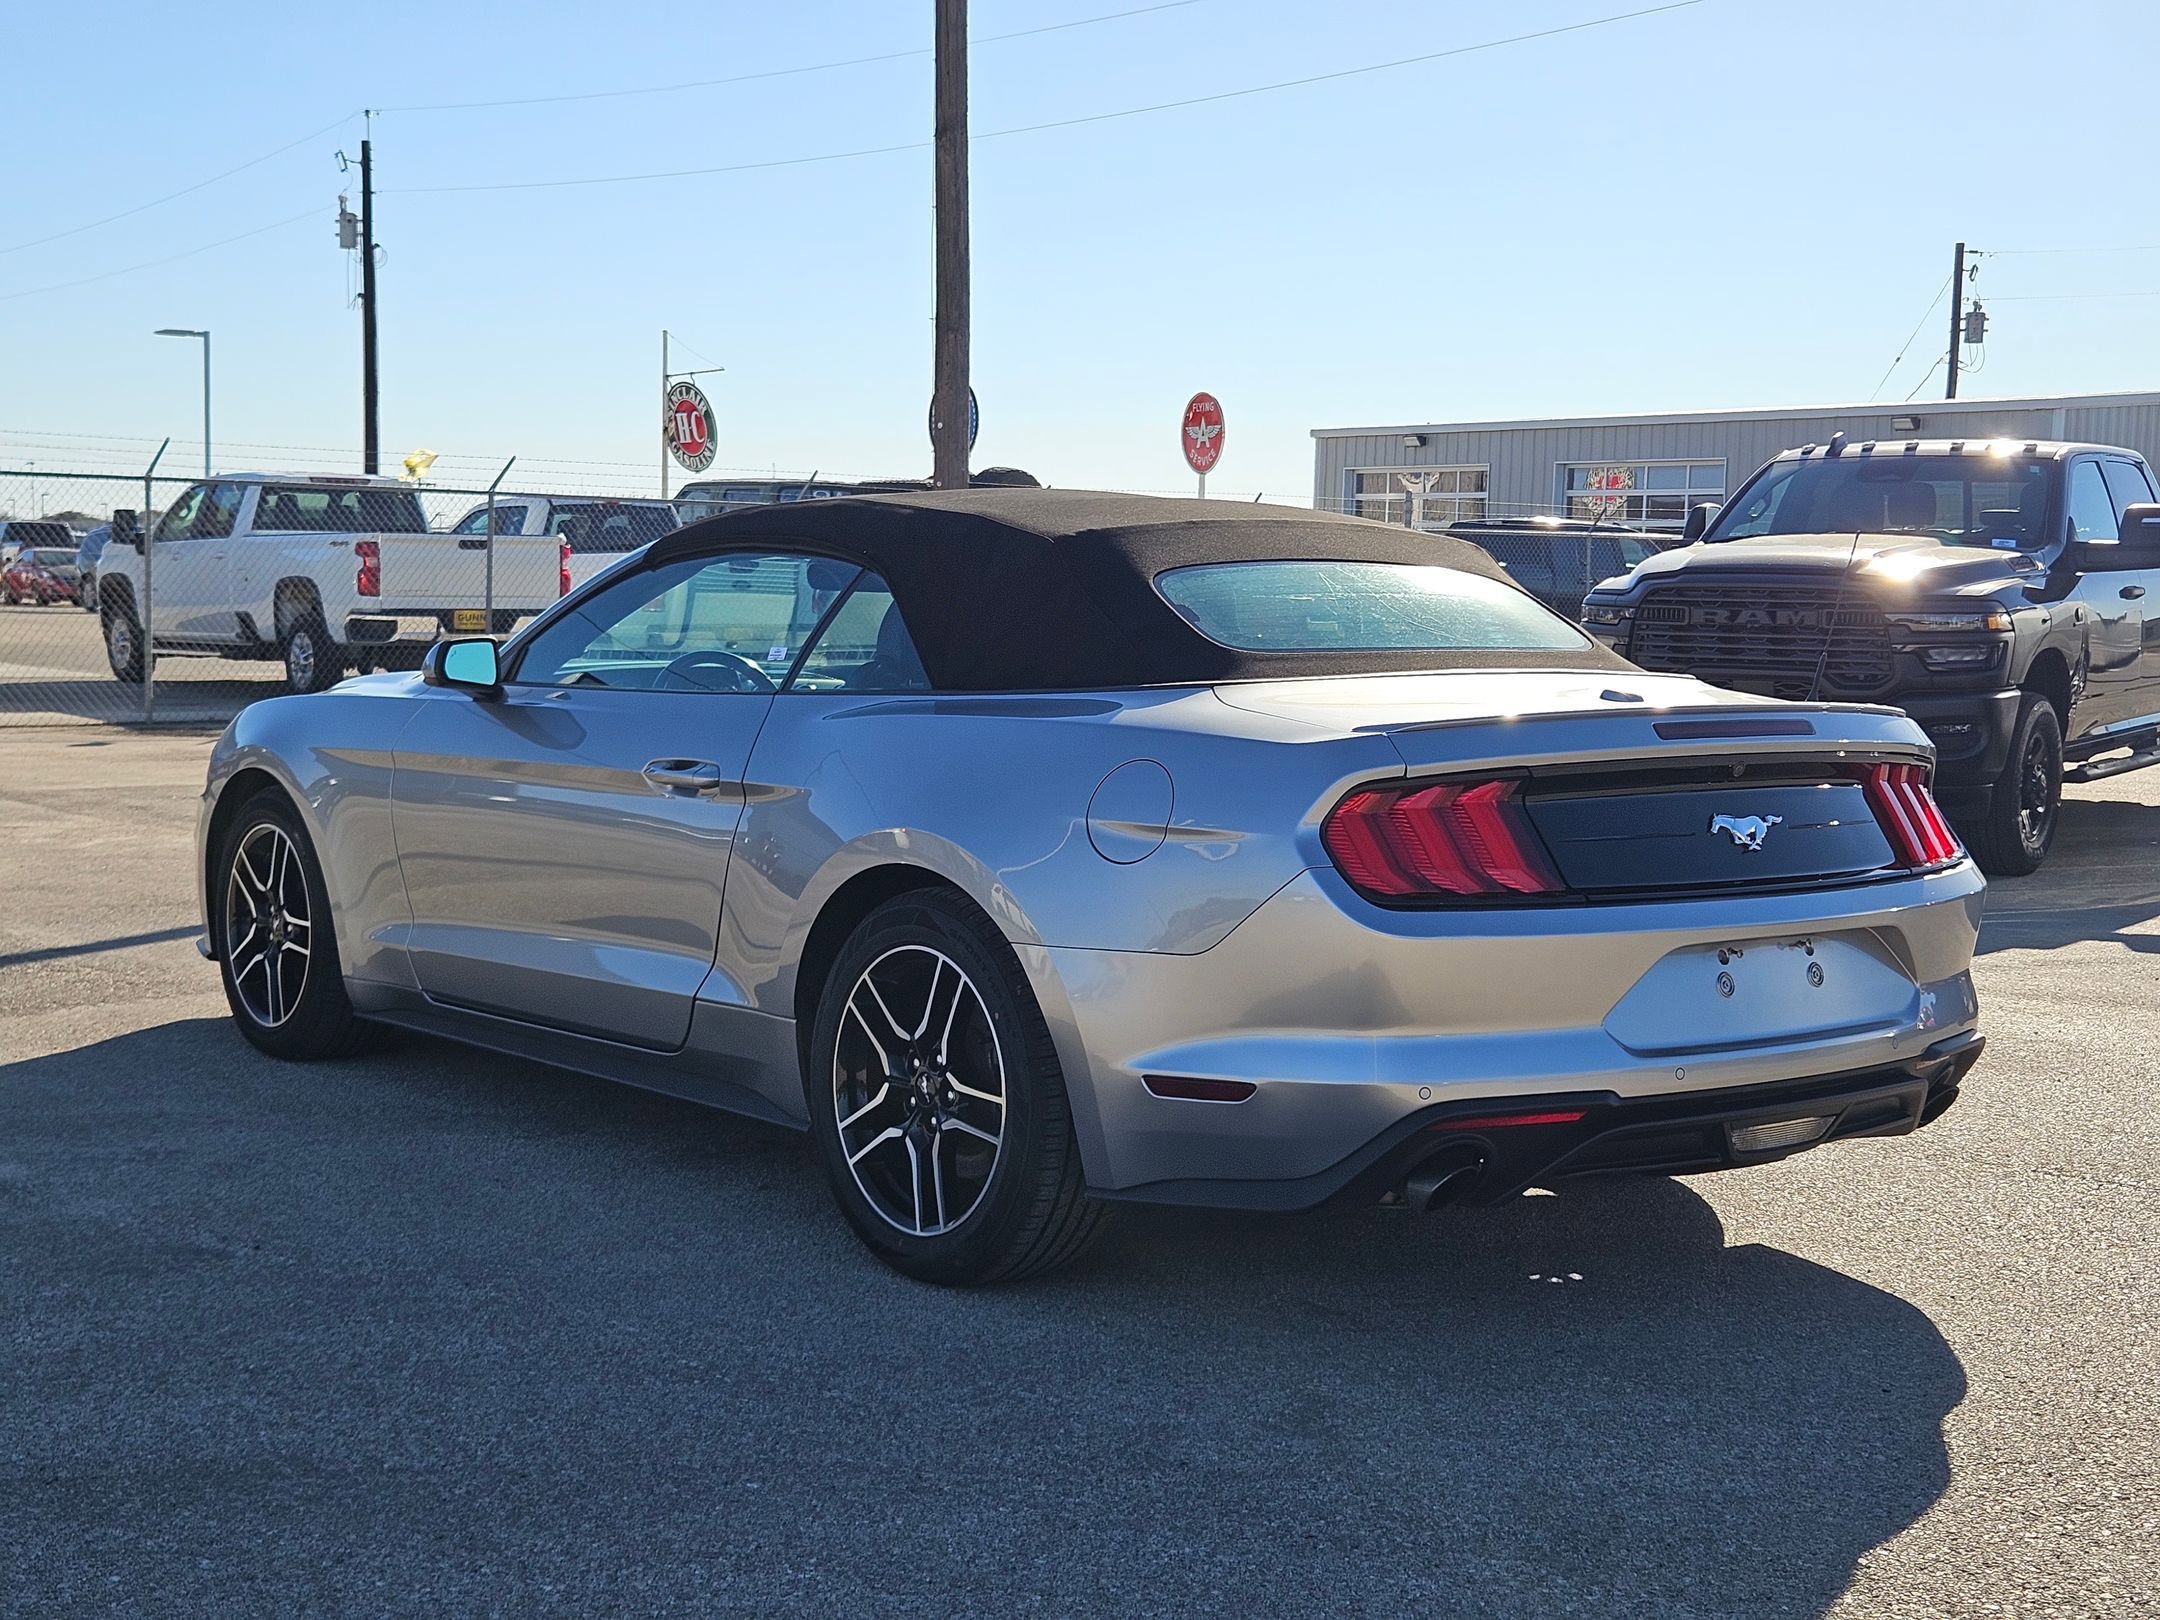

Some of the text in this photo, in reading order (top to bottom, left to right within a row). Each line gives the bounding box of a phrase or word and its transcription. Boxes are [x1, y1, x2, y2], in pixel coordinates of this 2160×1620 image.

[1192, 402, 1215, 413] FLYING
[671, 439, 714, 469] GASOLINE
[1189, 449, 1216, 466] SERVICE
[1690, 606, 1819, 627] RAM
